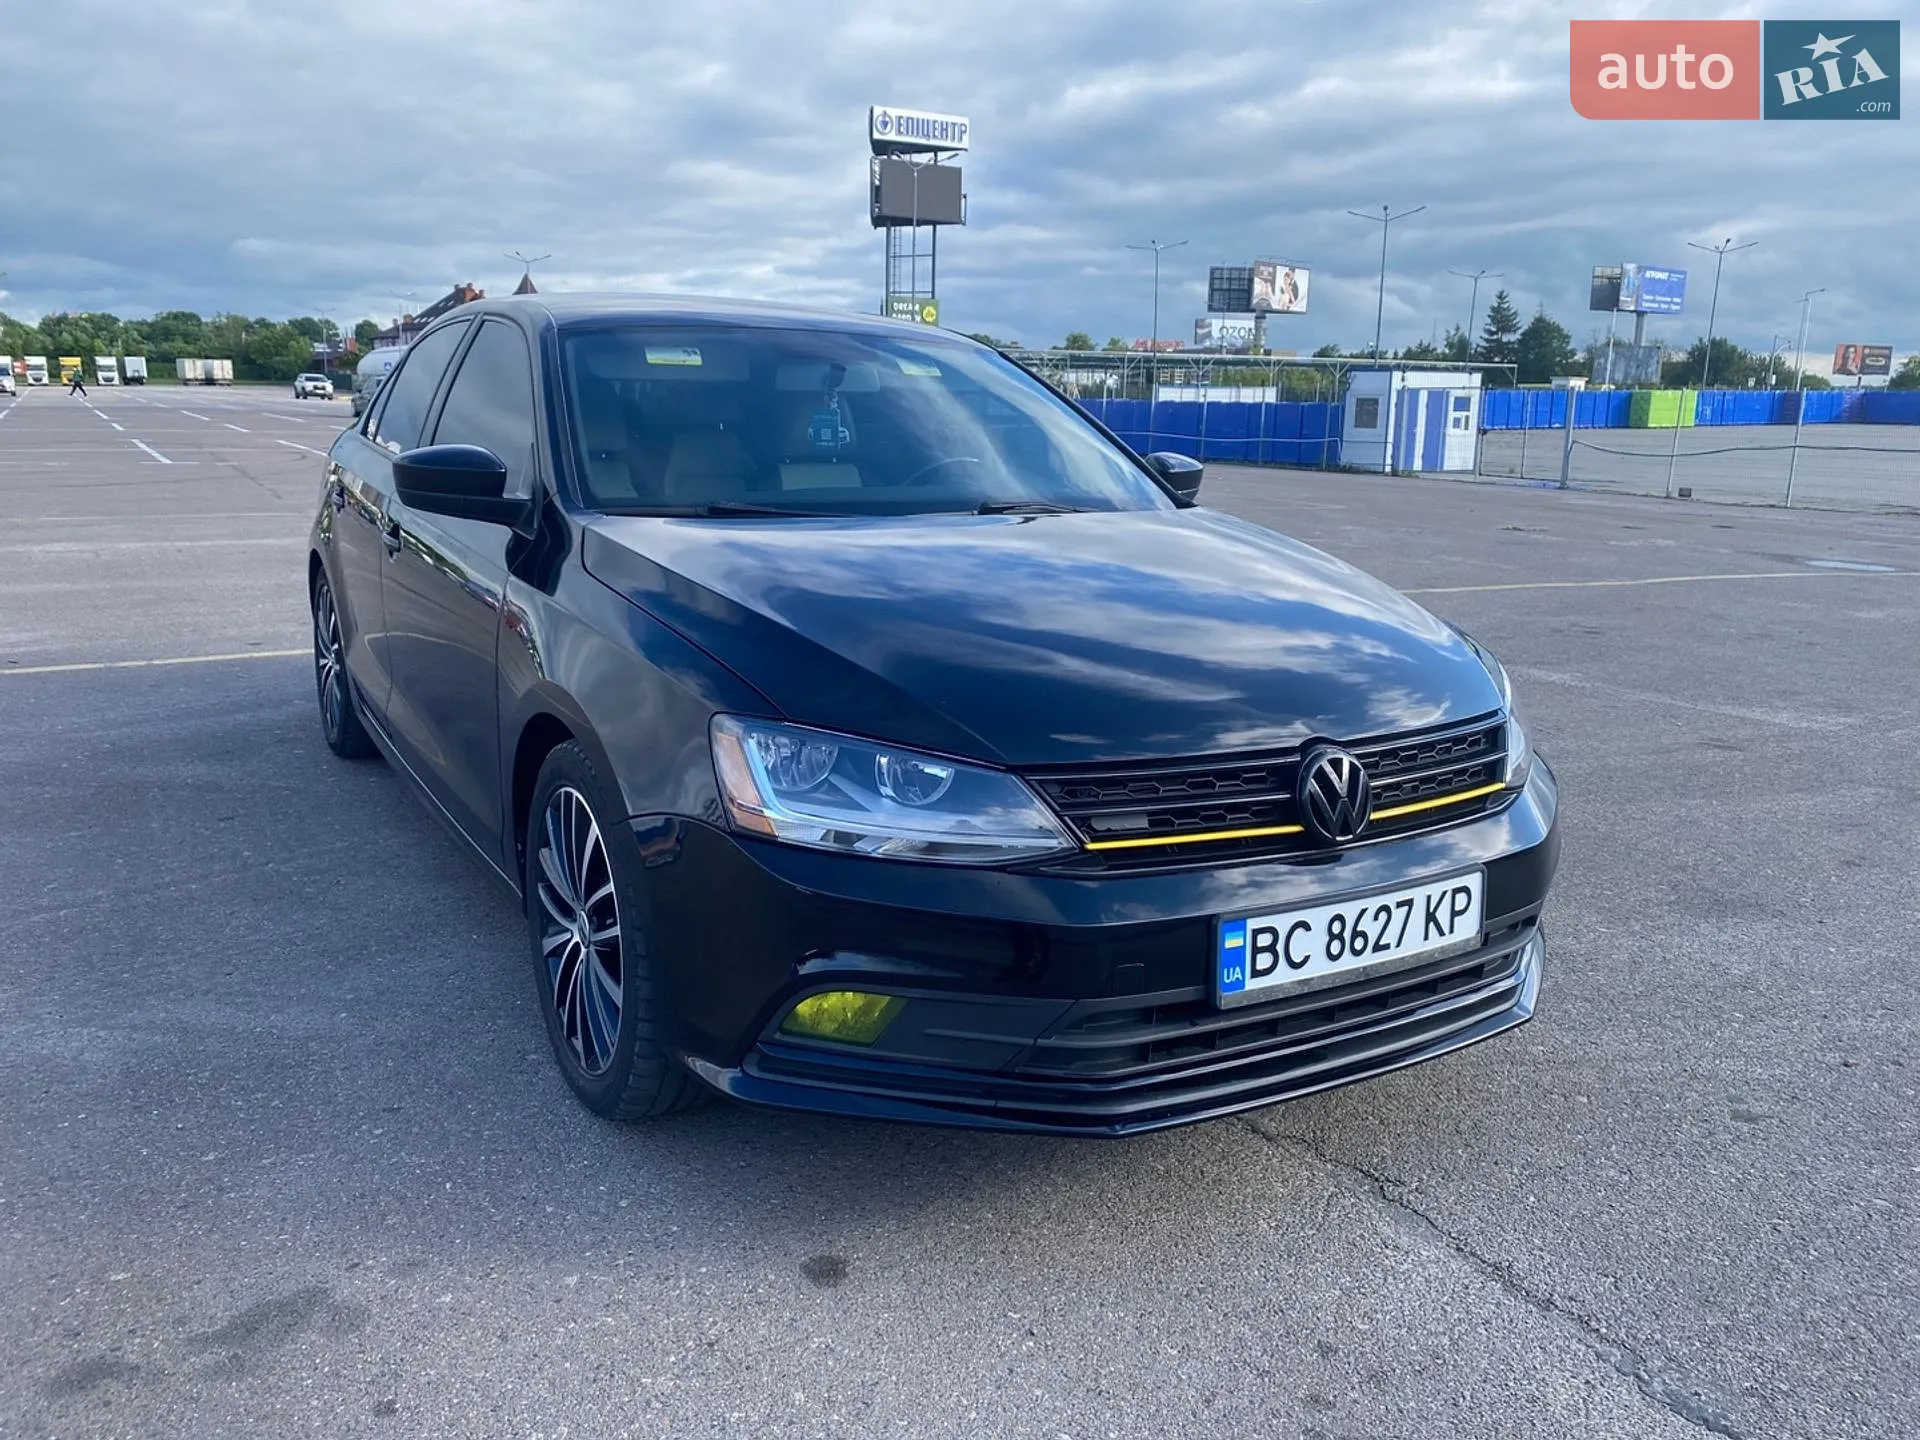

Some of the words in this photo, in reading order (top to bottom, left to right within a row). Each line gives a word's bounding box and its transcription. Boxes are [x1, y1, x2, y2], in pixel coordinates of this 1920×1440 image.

[894, 115, 968, 143] ЕПІЦЕНТР
[1250, 919, 1312, 979] BC
[1325, 897, 1415, 963] 8627
[1423, 885, 1473, 941] KP
[1223, 966, 1243, 984] UA
